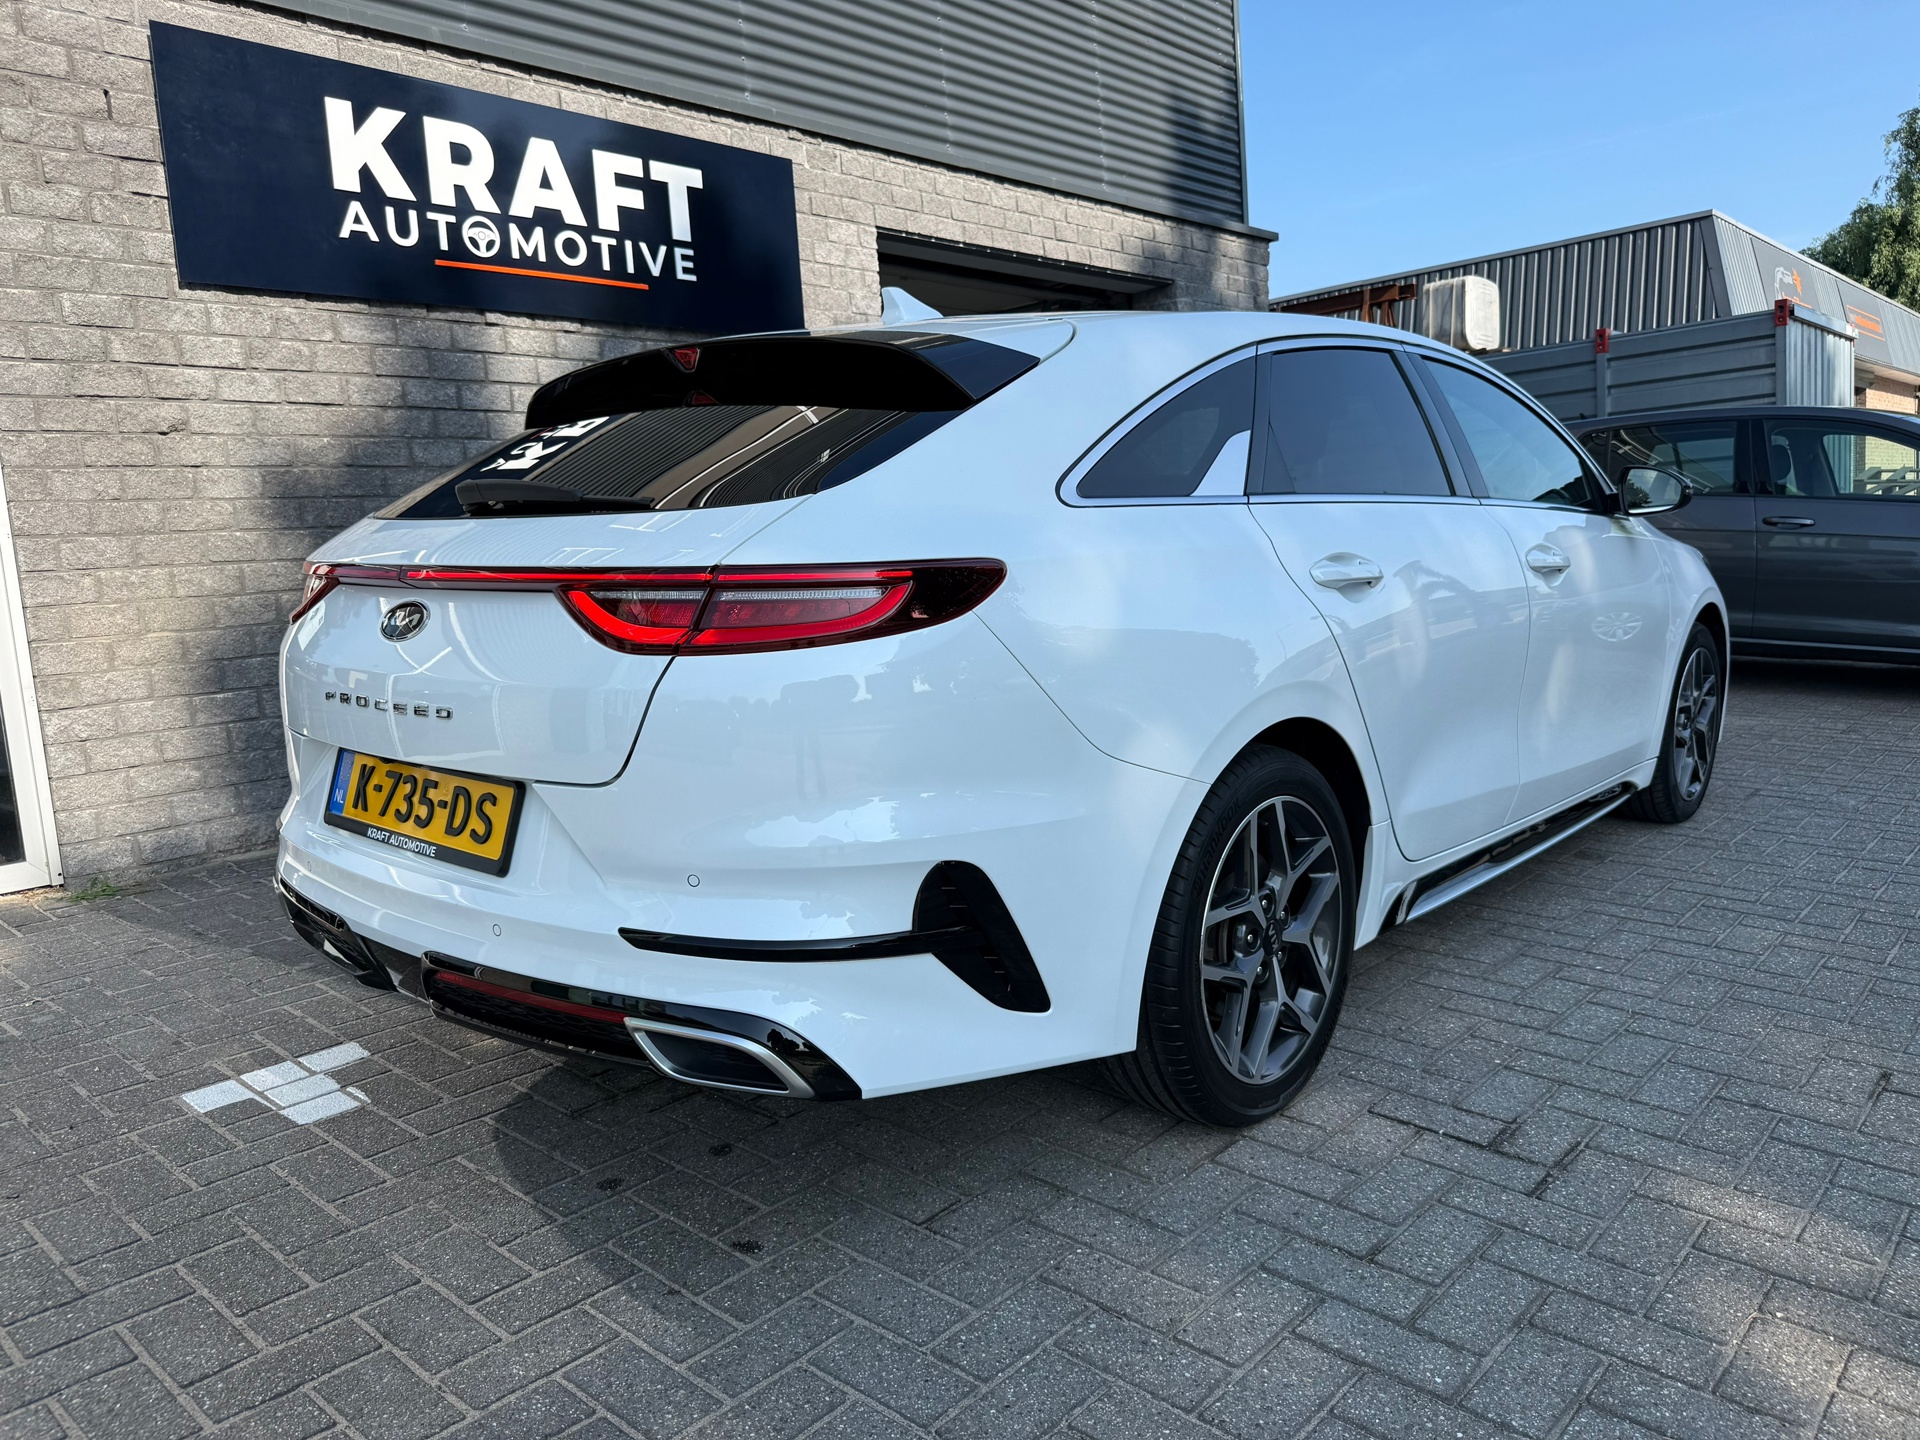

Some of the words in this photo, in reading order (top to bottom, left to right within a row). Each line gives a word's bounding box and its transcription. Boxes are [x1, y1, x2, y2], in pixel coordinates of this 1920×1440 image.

[323, 96, 703, 242] KRAFT
[338, 200, 697, 282] AUTOMOTIVE
[325, 691, 453, 720] PROCEED
[334, 788, 344, 804] NL
[352, 764, 497, 844] K-735-DS
[367, 827, 390, 842] KRAFT
[389, 834, 436, 857] AUTOMOTIVE
